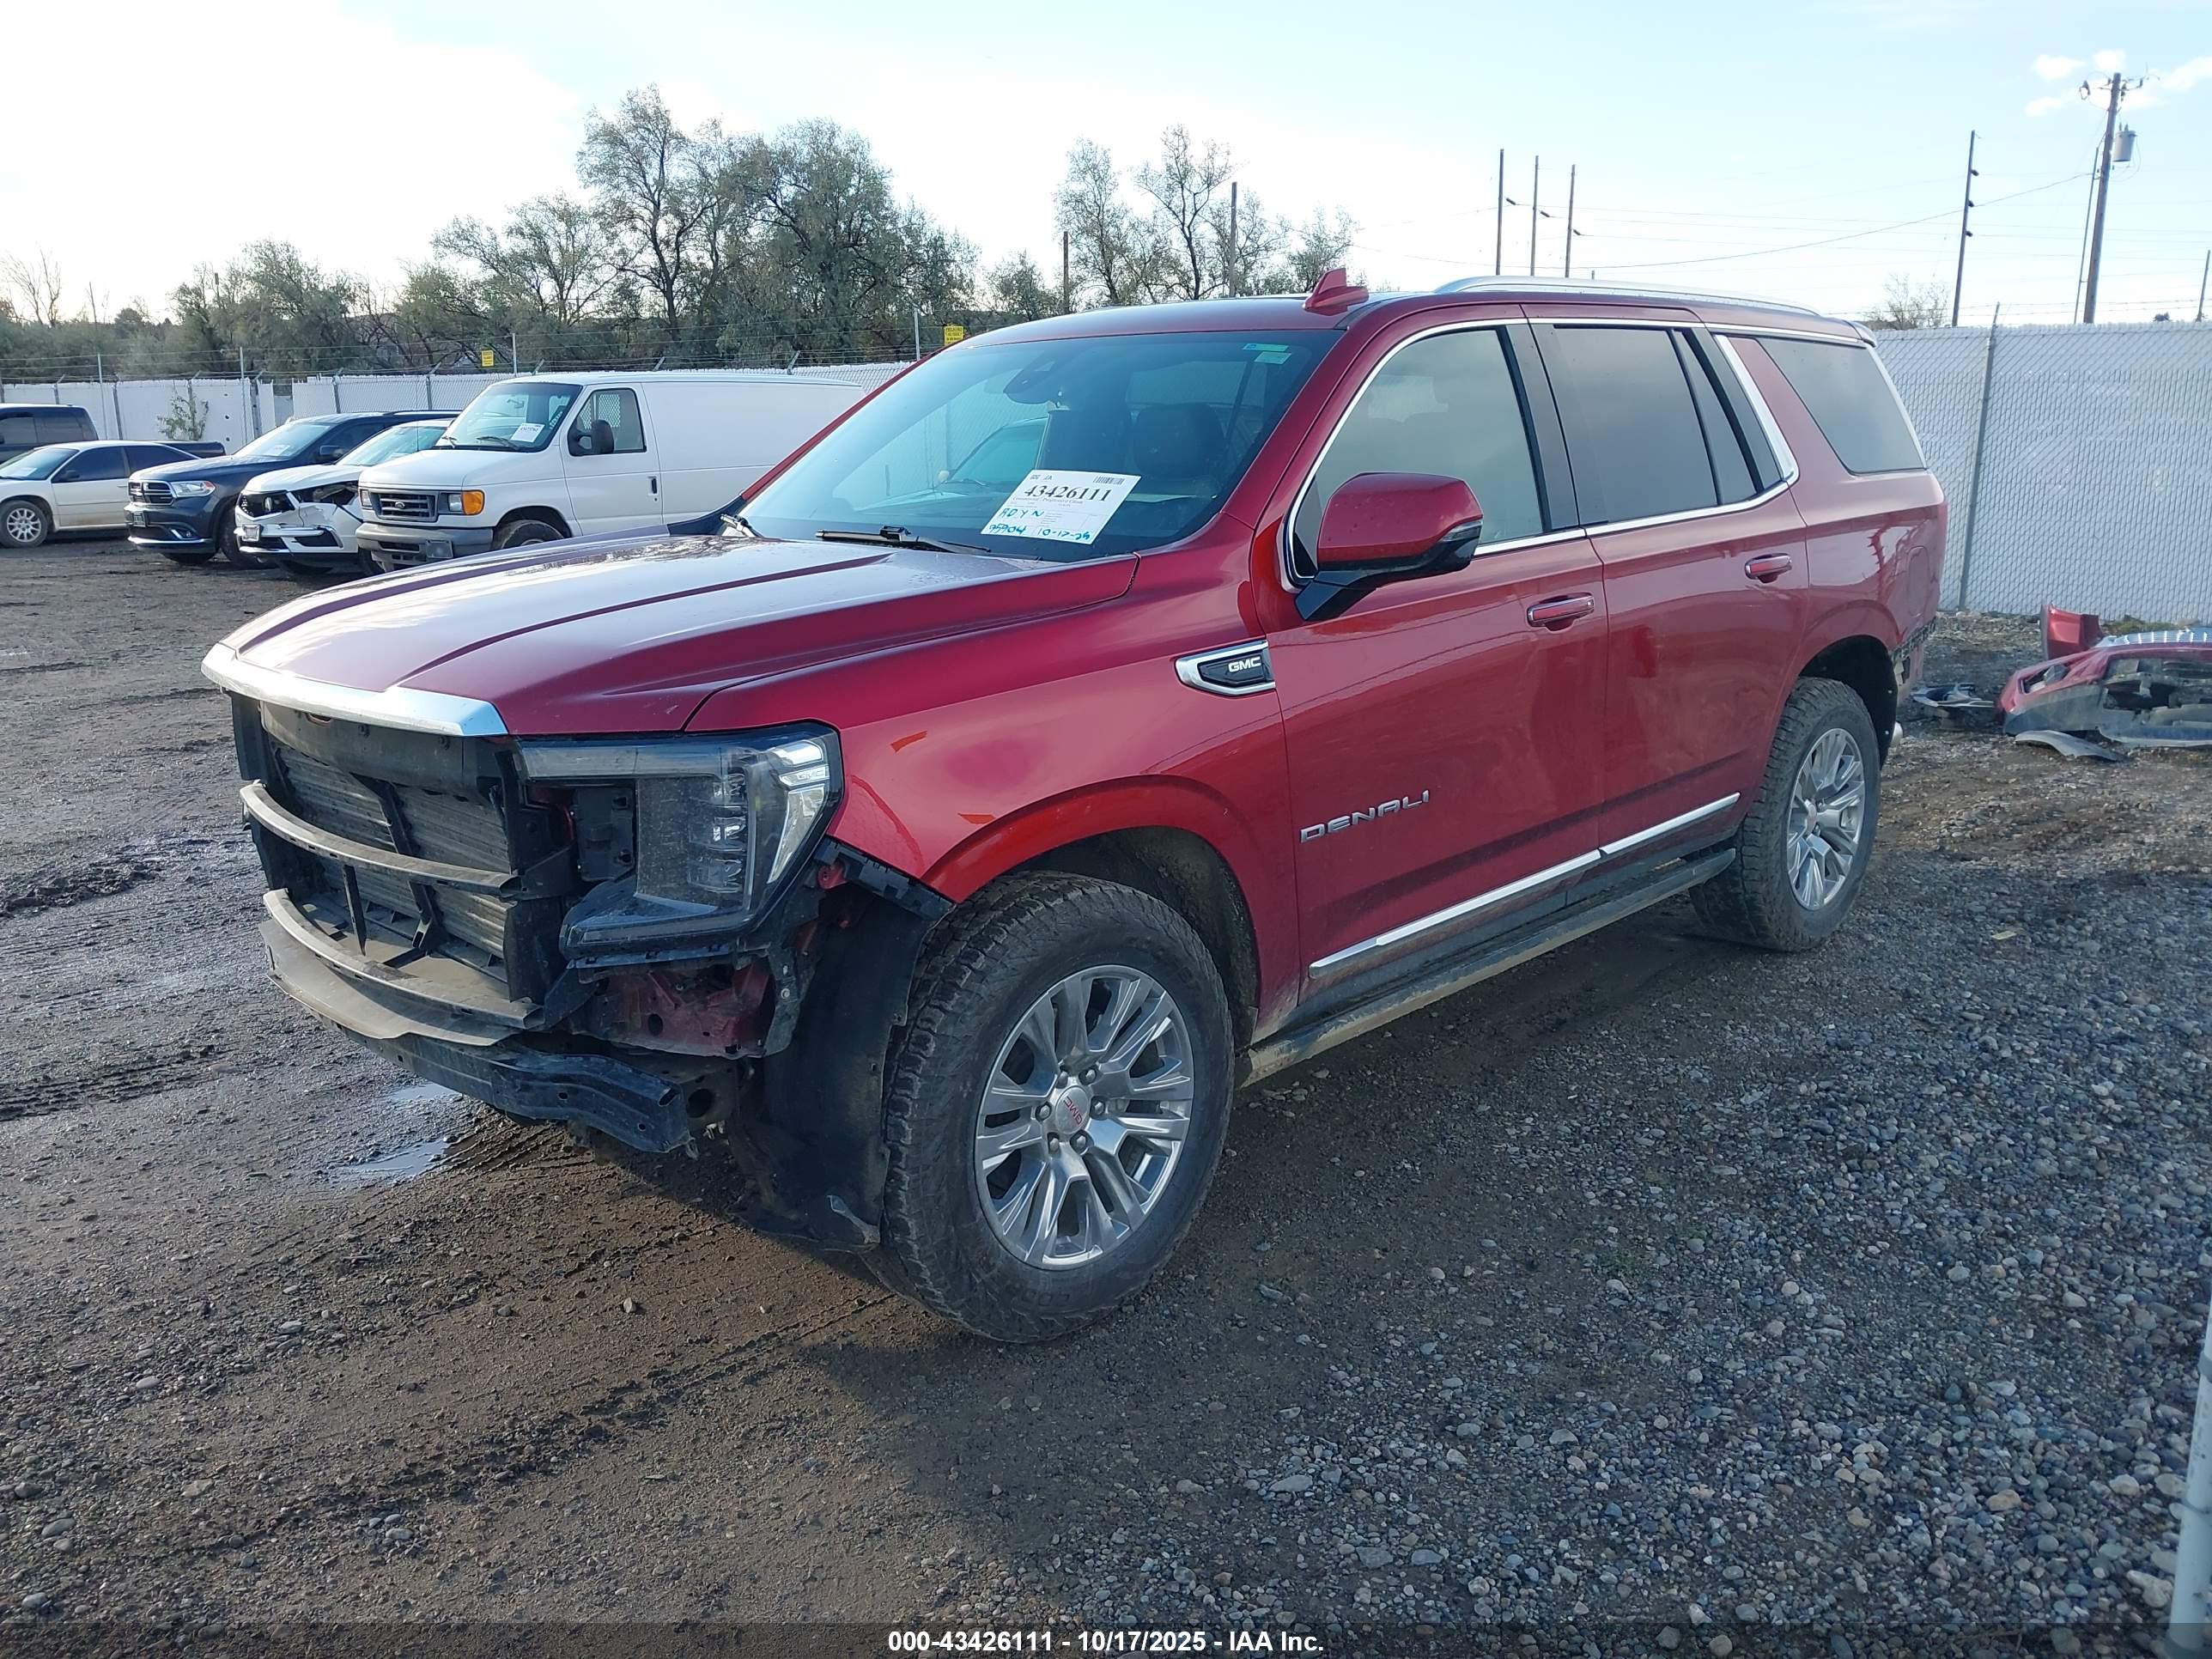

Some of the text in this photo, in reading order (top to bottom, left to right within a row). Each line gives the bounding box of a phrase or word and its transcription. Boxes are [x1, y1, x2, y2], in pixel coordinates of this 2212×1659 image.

[1024, 485, 1112, 501] 43426111
[1037, 528, 1091, 540] 10-17-25
[1228, 656, 1261, 672] GMC
[1300, 789, 1430, 843] DENALI
